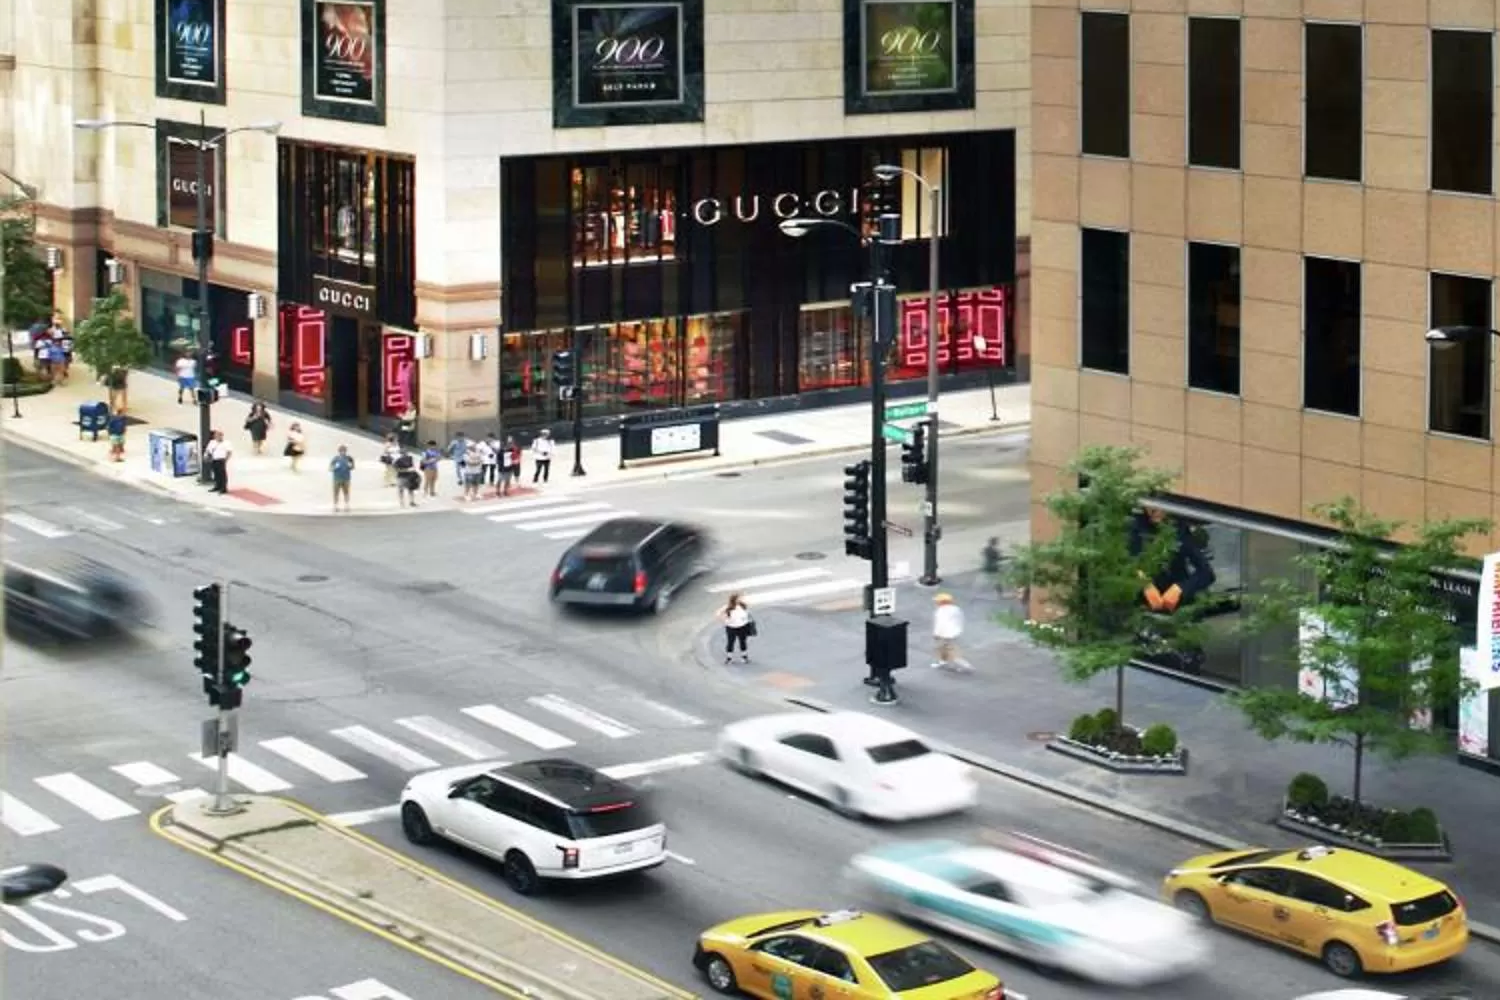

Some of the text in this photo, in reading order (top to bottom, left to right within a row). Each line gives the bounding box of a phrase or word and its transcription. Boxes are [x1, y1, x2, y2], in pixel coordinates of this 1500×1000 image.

[176, 22, 210, 43] 900
[325, 32, 367, 59] 900
[881, 29, 941, 55] 900
[595, 36, 665, 63] 900
[173, 177, 212, 197] GUCI
[694, 187, 858, 225] GUCCI
[319, 286, 370, 311] GUCCI
